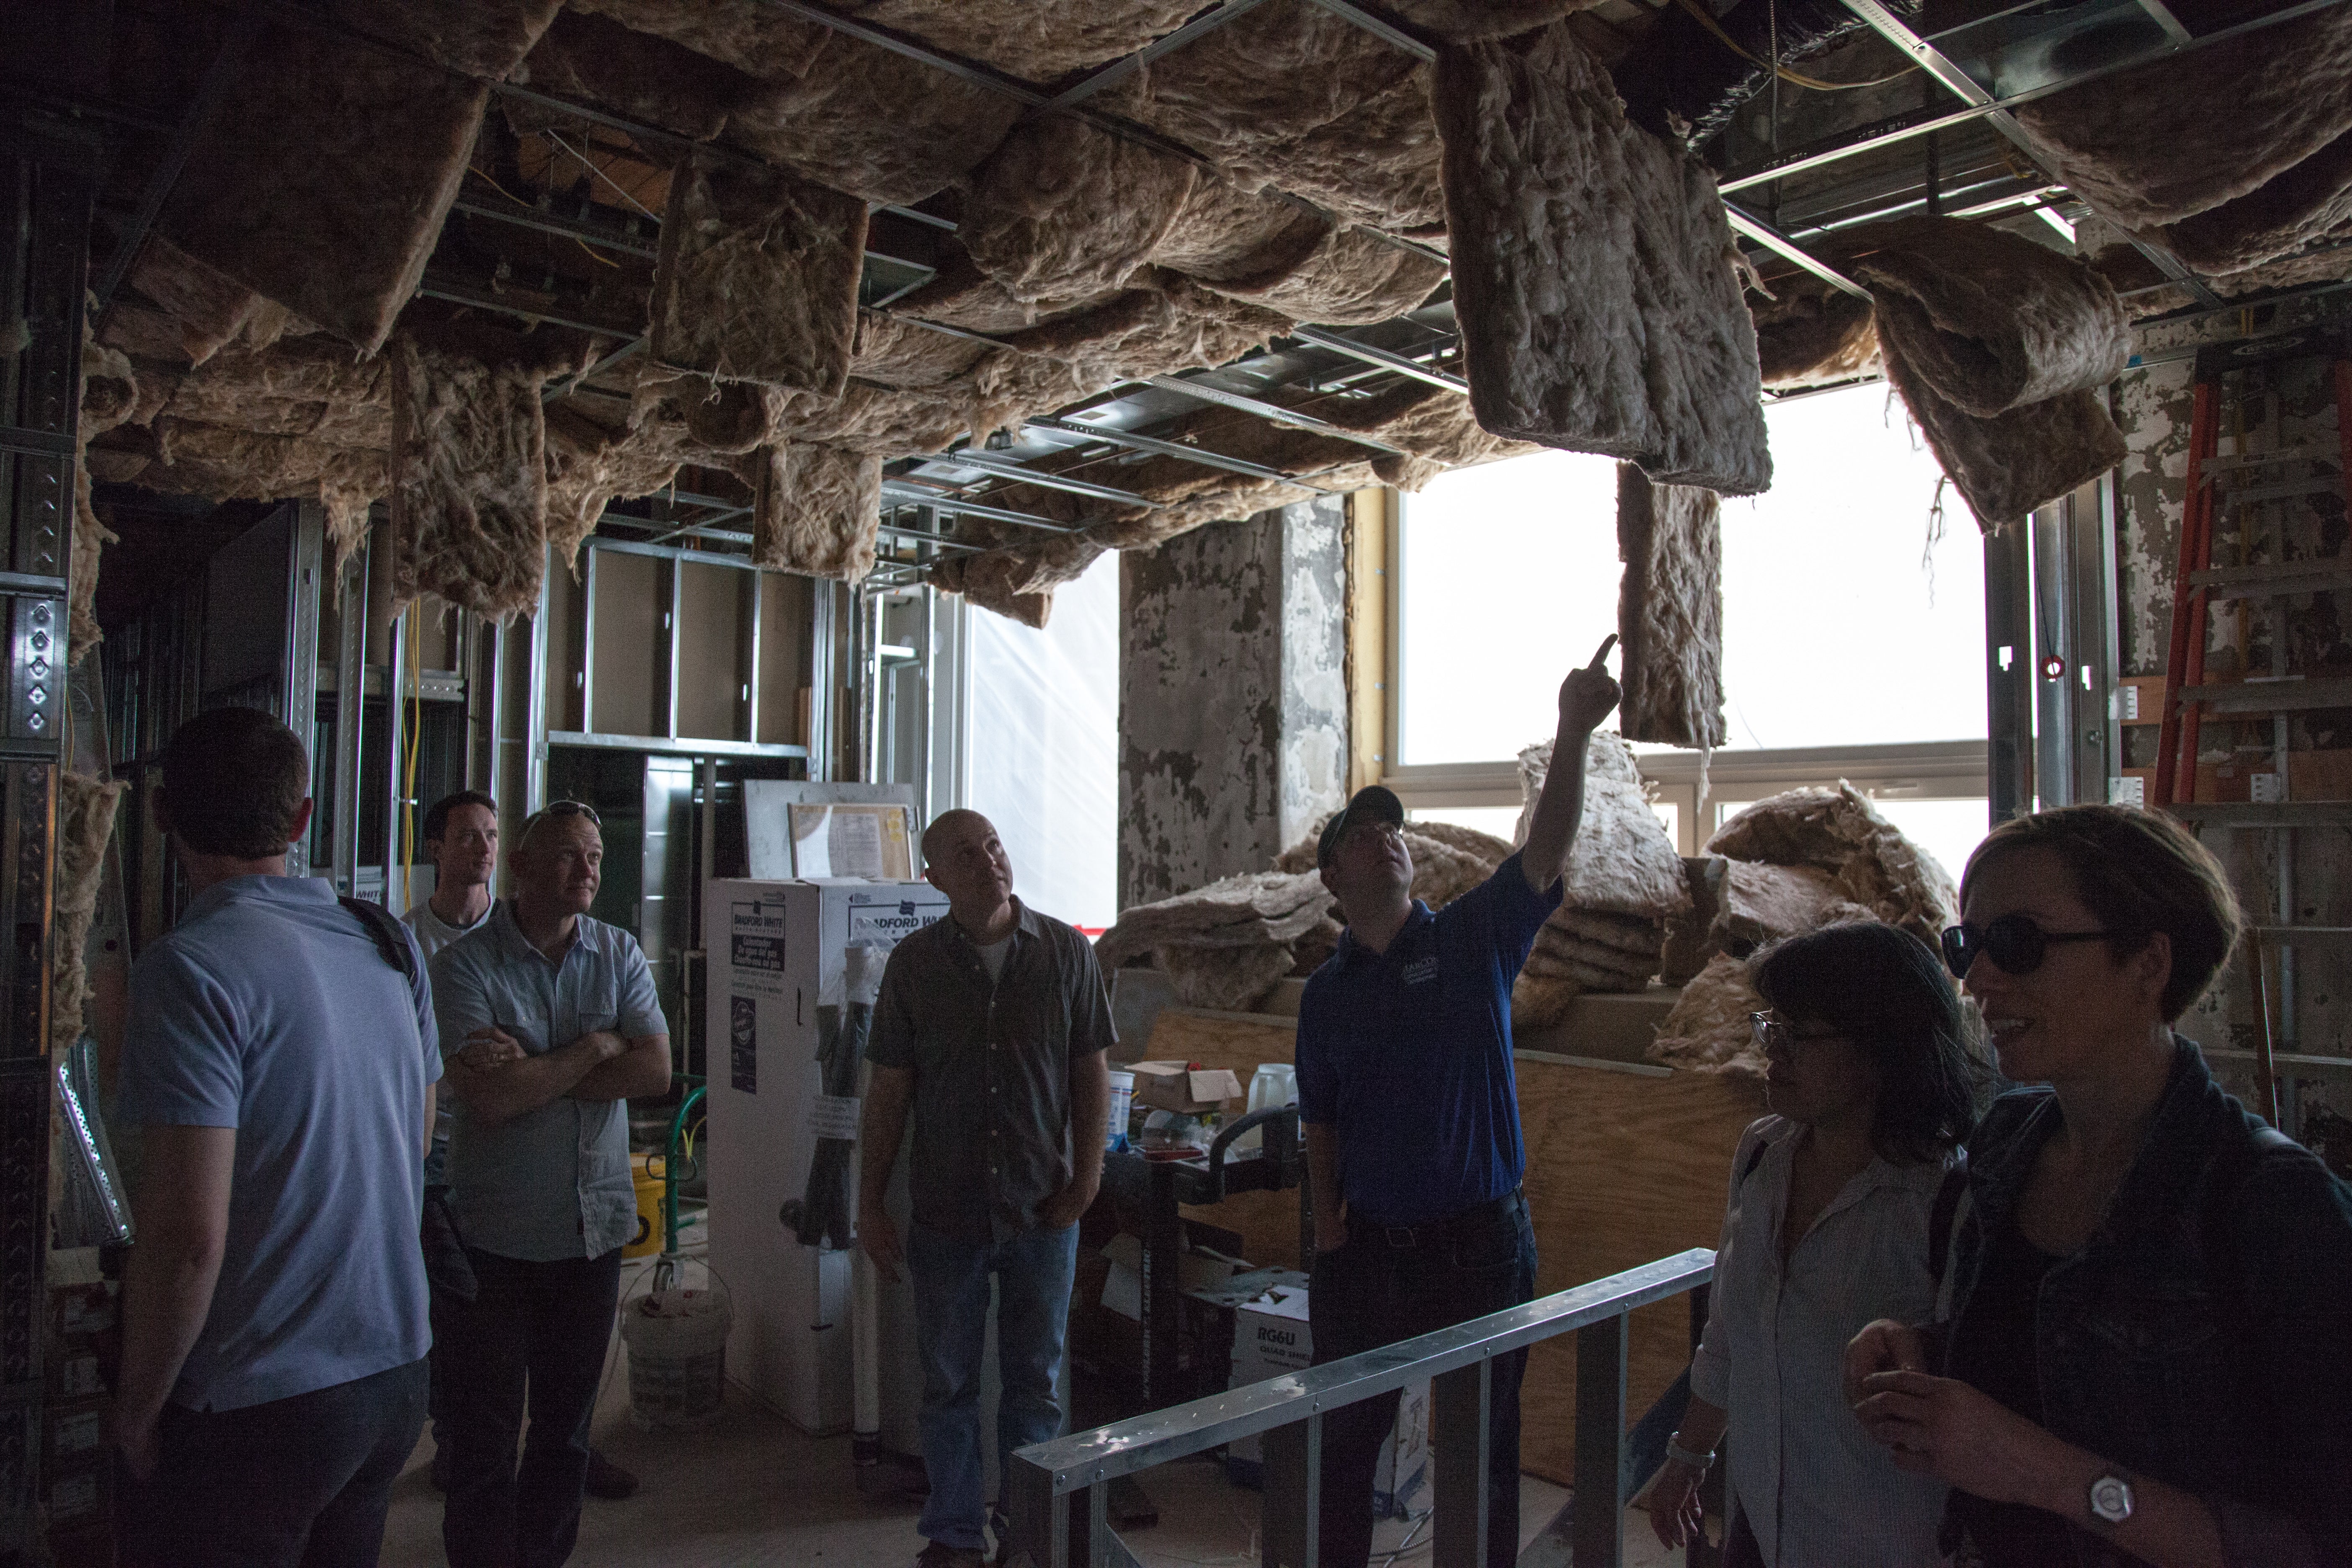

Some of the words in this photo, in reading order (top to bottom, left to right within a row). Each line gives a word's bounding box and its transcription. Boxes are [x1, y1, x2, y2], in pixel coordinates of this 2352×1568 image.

[357, 890, 378, 899] WHIT
[735, 915, 763, 926] BRADFORD
[764, 916, 783, 928] WHITE
[1258, 1327, 1295, 1346] RG6U
[1260, 1345, 1286, 1357] QUAD
[1288, 1351, 1311, 1362] SHIEL
